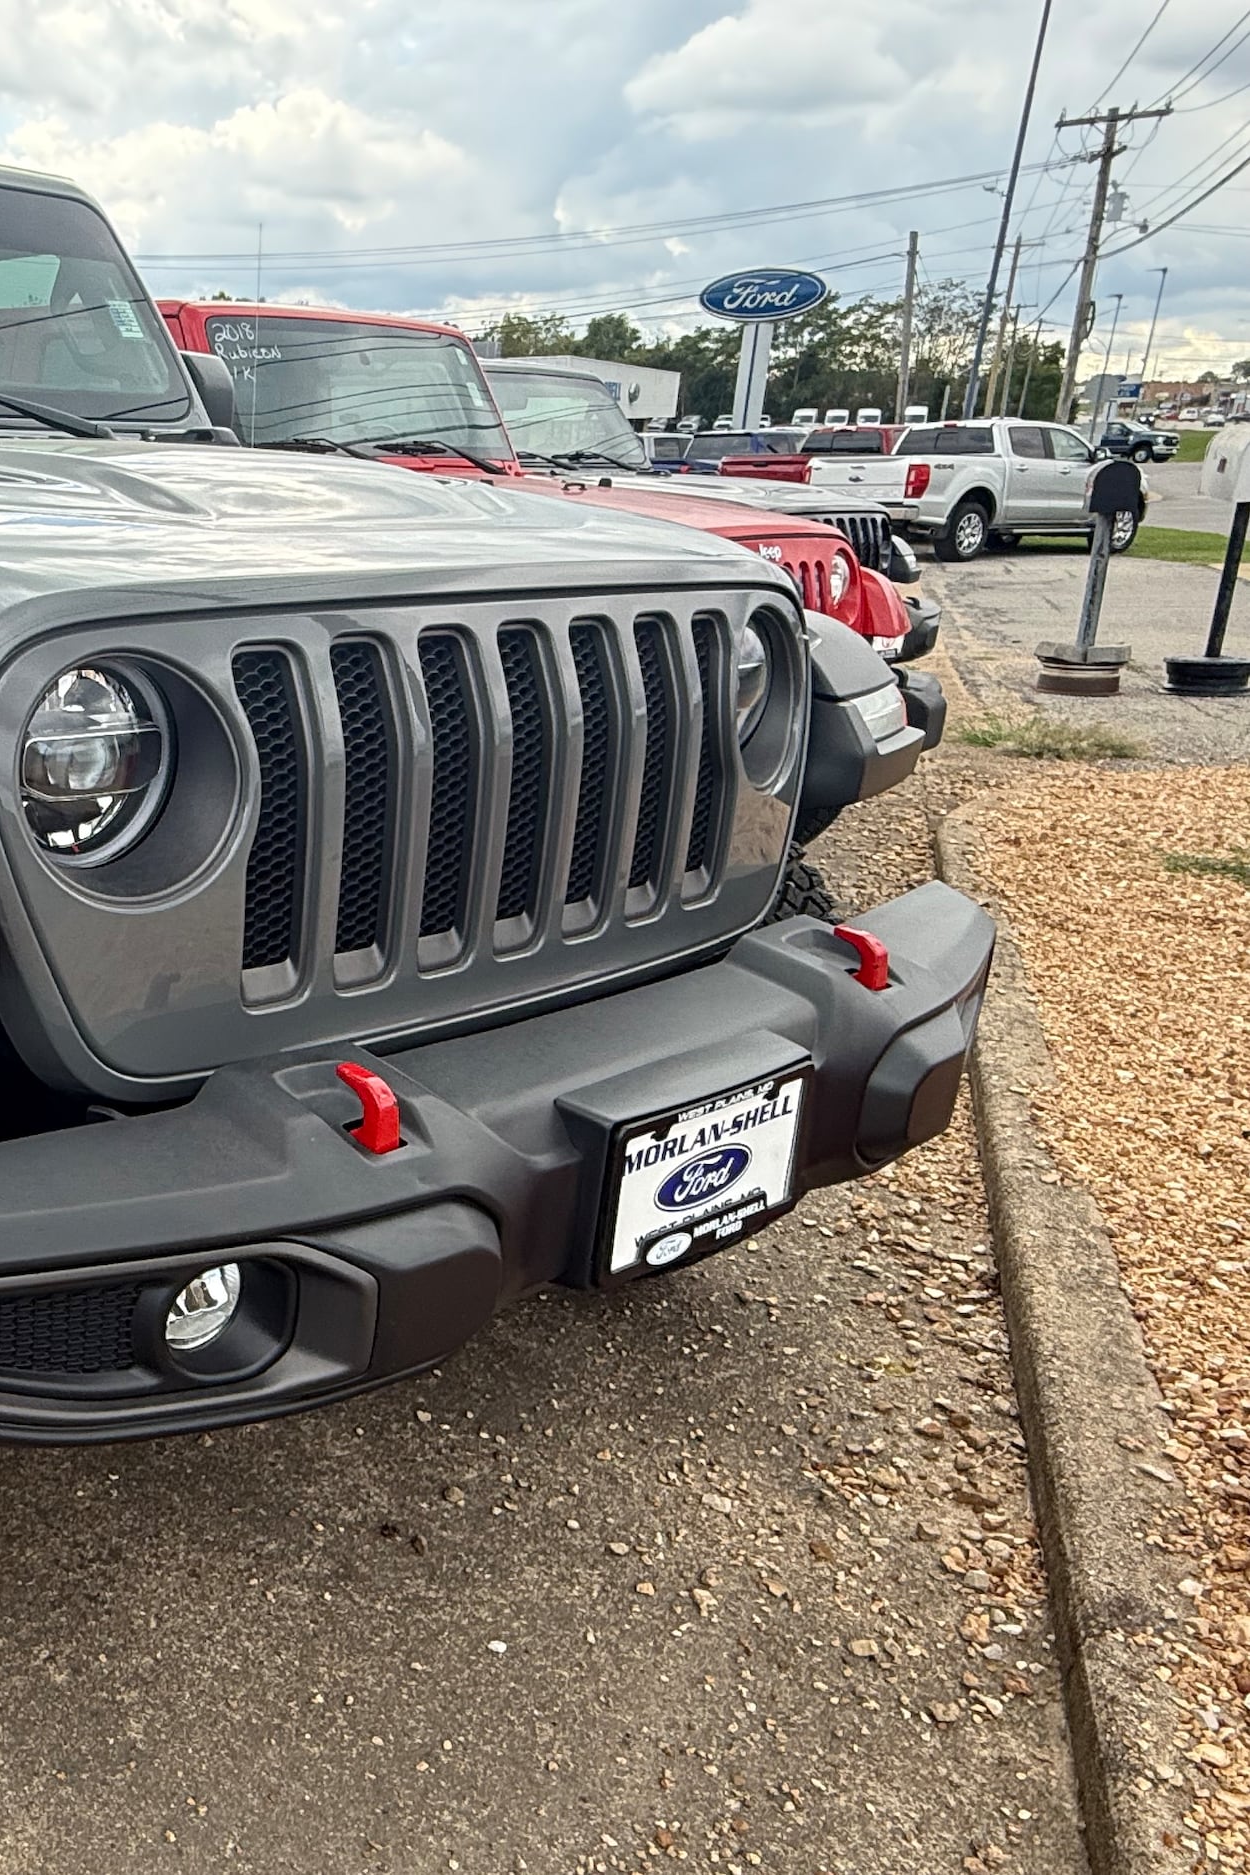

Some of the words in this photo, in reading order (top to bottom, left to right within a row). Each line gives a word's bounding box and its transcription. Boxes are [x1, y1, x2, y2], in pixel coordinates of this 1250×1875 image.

[723, 278, 801, 310] Ford
[211, 322, 255, 342] 2018
[758, 543, 783, 562] Jeep
[624, 1095, 793, 1177] MORLAN-SHELL
[673, 1153, 735, 1203] Ford
[715, 1220, 743, 1241] FORD
